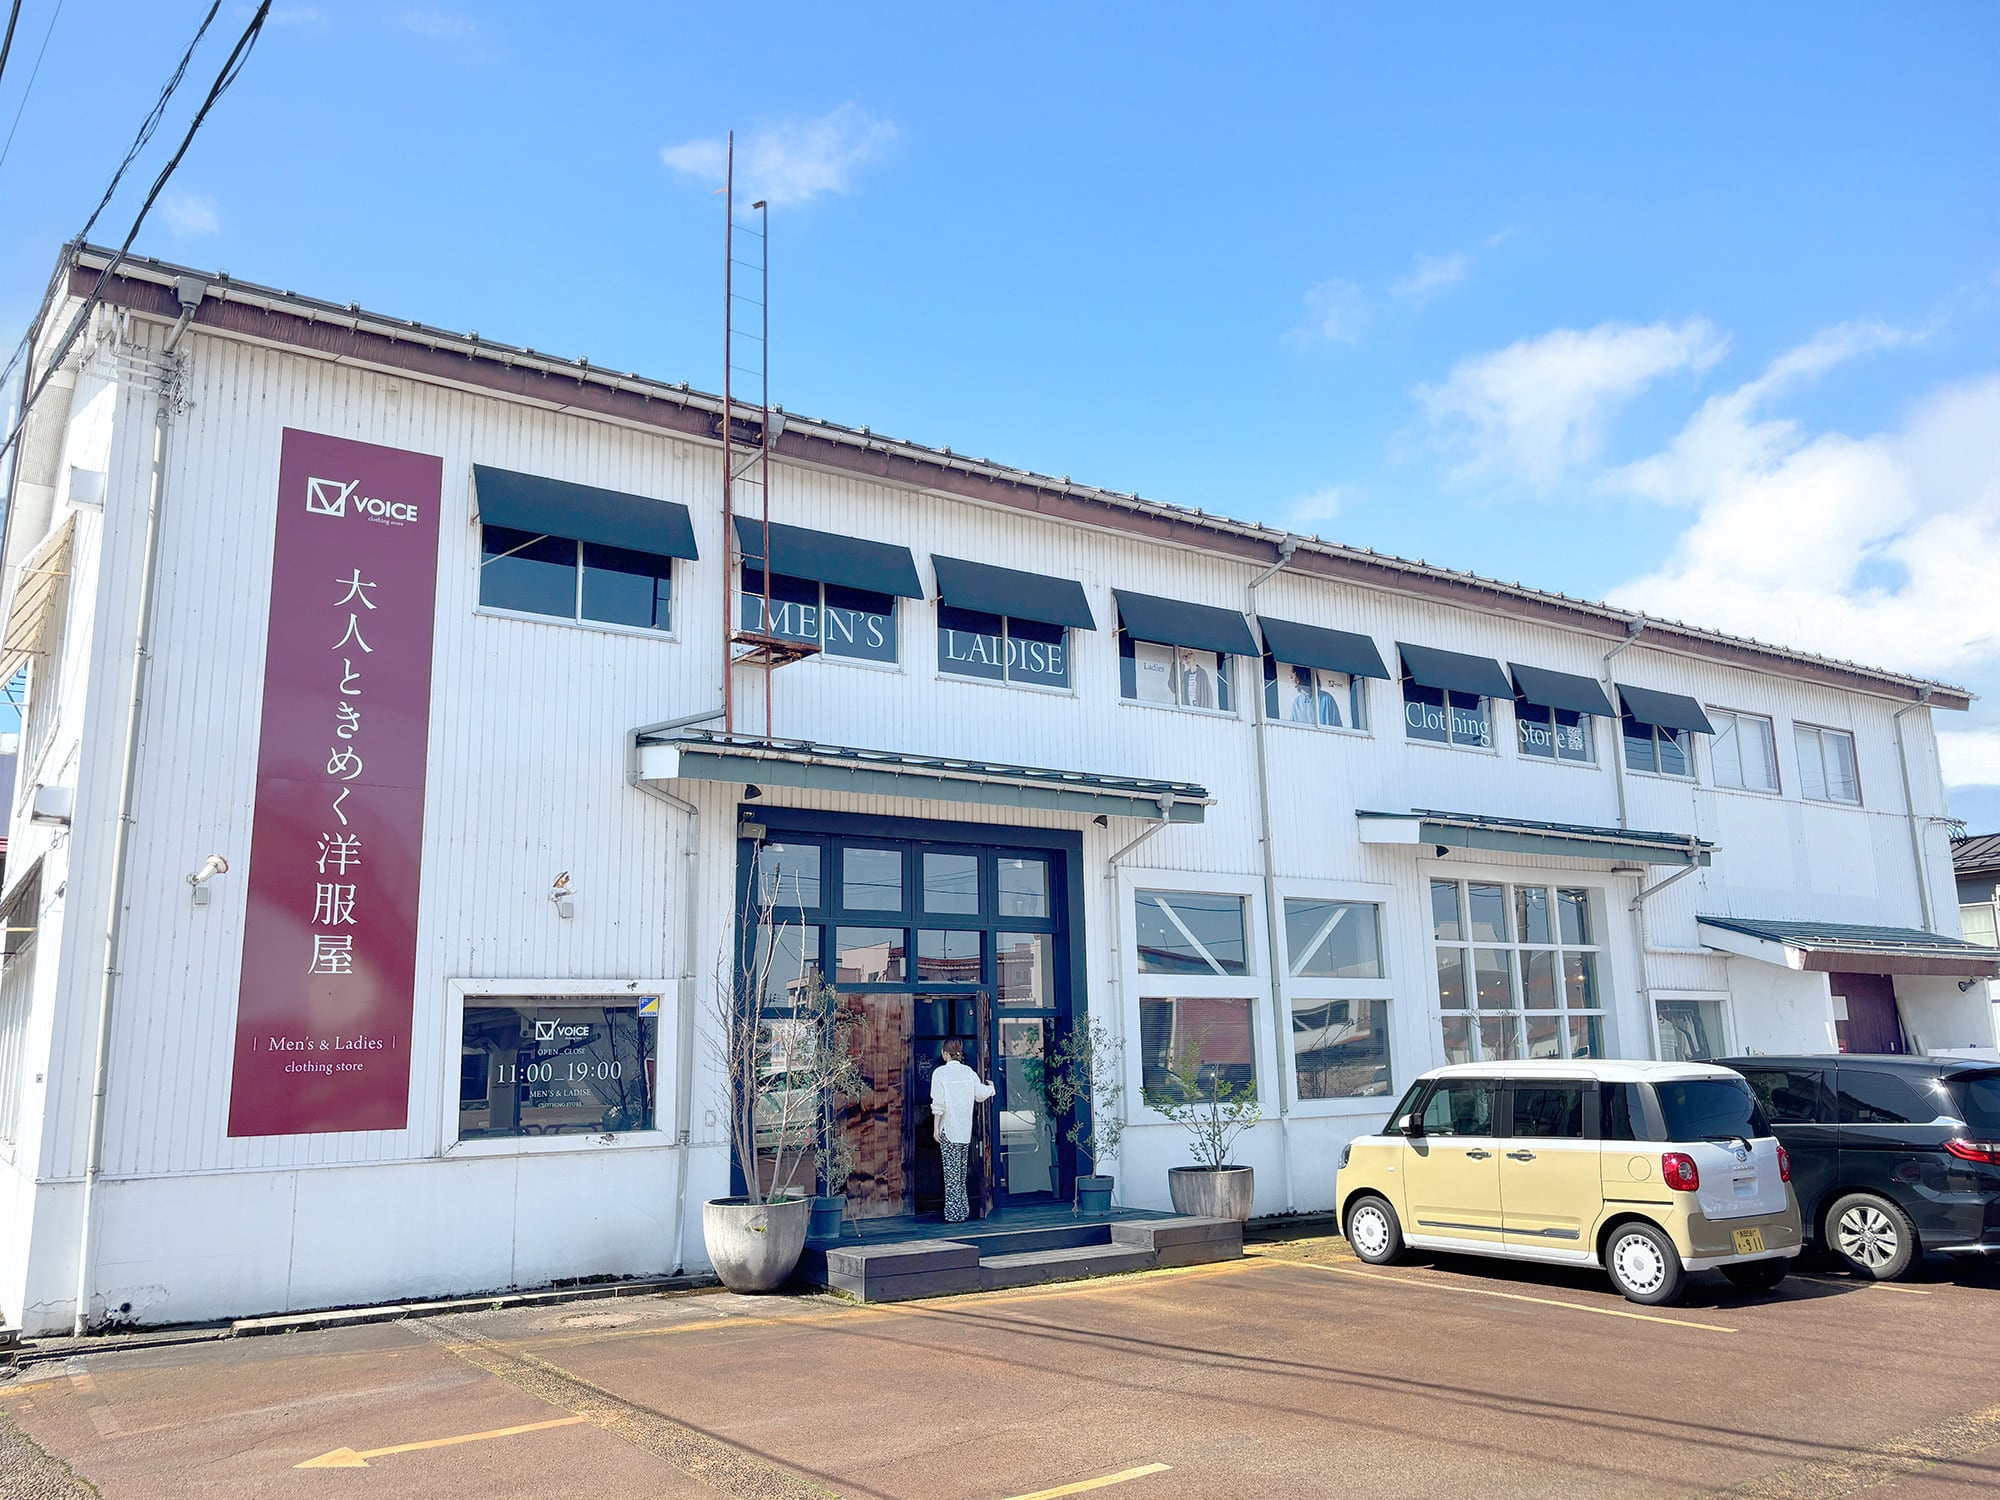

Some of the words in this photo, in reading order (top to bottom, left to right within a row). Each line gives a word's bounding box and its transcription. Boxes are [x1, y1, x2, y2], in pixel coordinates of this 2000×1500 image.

[353, 495, 418, 522] VOICE
[755, 598, 884, 648] MEN'S
[946, 630, 1065, 675] LADISE
[1405, 702, 1490, 747] Clothing
[1519, 720, 1566, 749] Store
[307, 568, 378, 976] 大人ときめく洋服屋
[557, 1026, 590, 1036] VOICE
[269, 1036, 314, 1051] Men's
[319, 1039, 330, 1051] &
[335, 1035, 383, 1050] Ladies
[284, 1061, 333, 1076] clothing
[335, 1061, 364, 1072] store
[530, 1090, 554, 1098] MEN'S
